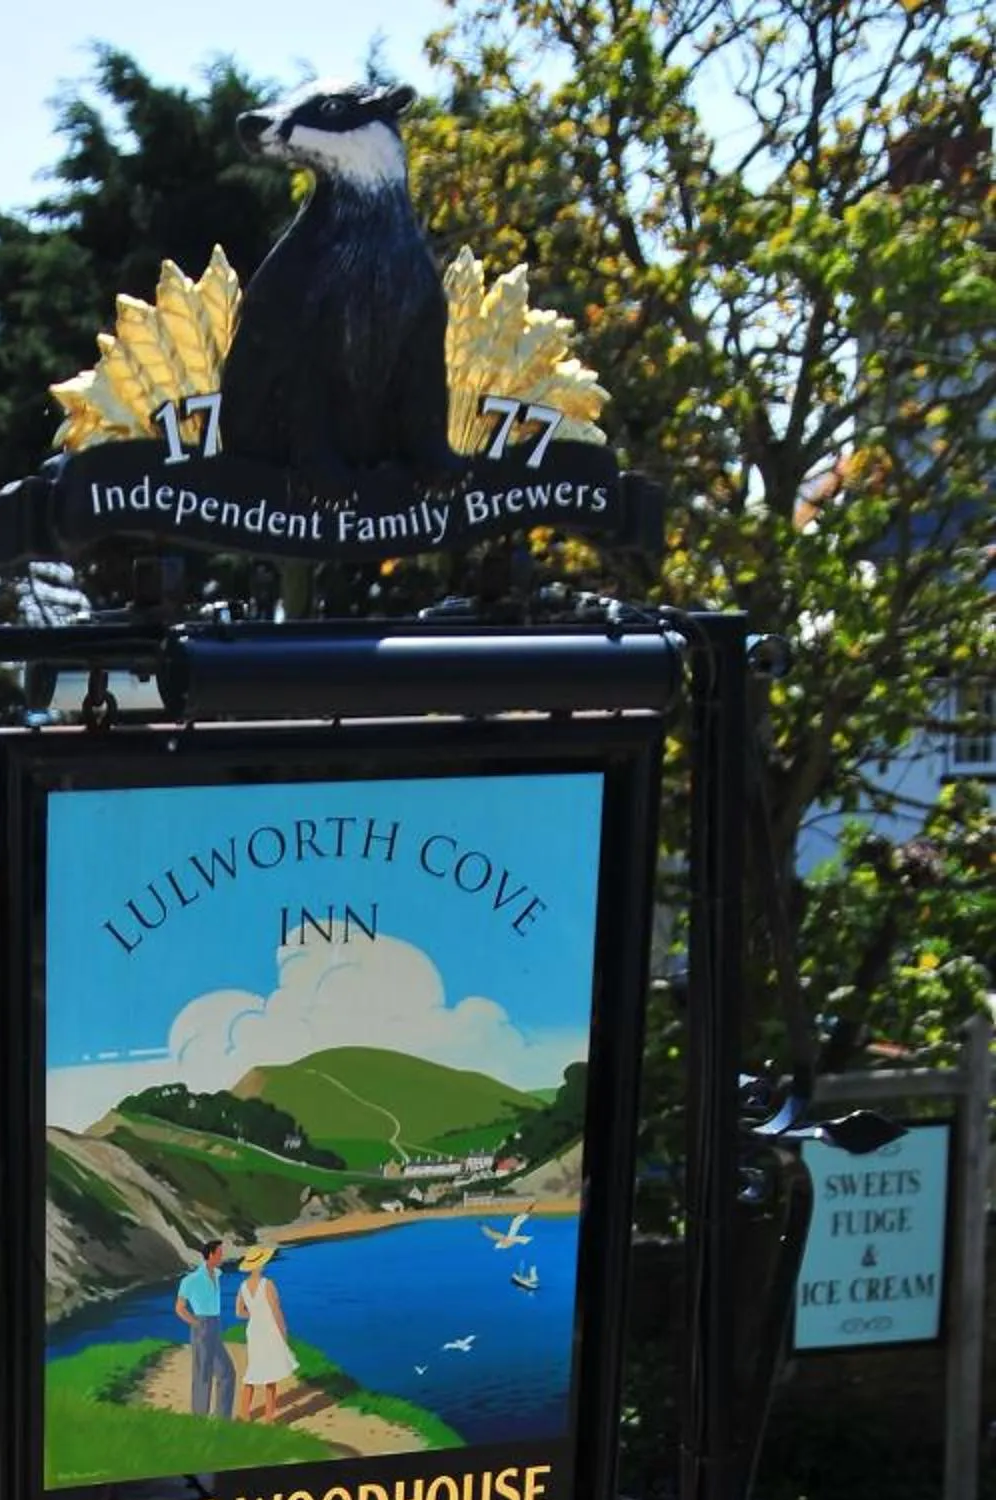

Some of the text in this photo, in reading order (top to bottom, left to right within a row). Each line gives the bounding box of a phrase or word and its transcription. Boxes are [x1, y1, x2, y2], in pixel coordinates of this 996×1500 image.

[152, 393, 566, 469] 17 77
[90, 475, 608, 544] Independent Family Brewers
[103, 816, 549, 955] LULWORTH COVE
[279, 903, 380, 946] INN
[824, 1169, 922, 1200] SWEETS
[830, 1207, 914, 1238] FUDGE
[860, 1244, 878, 1267] &
[801, 1273, 937, 1308] ICE CREAM
